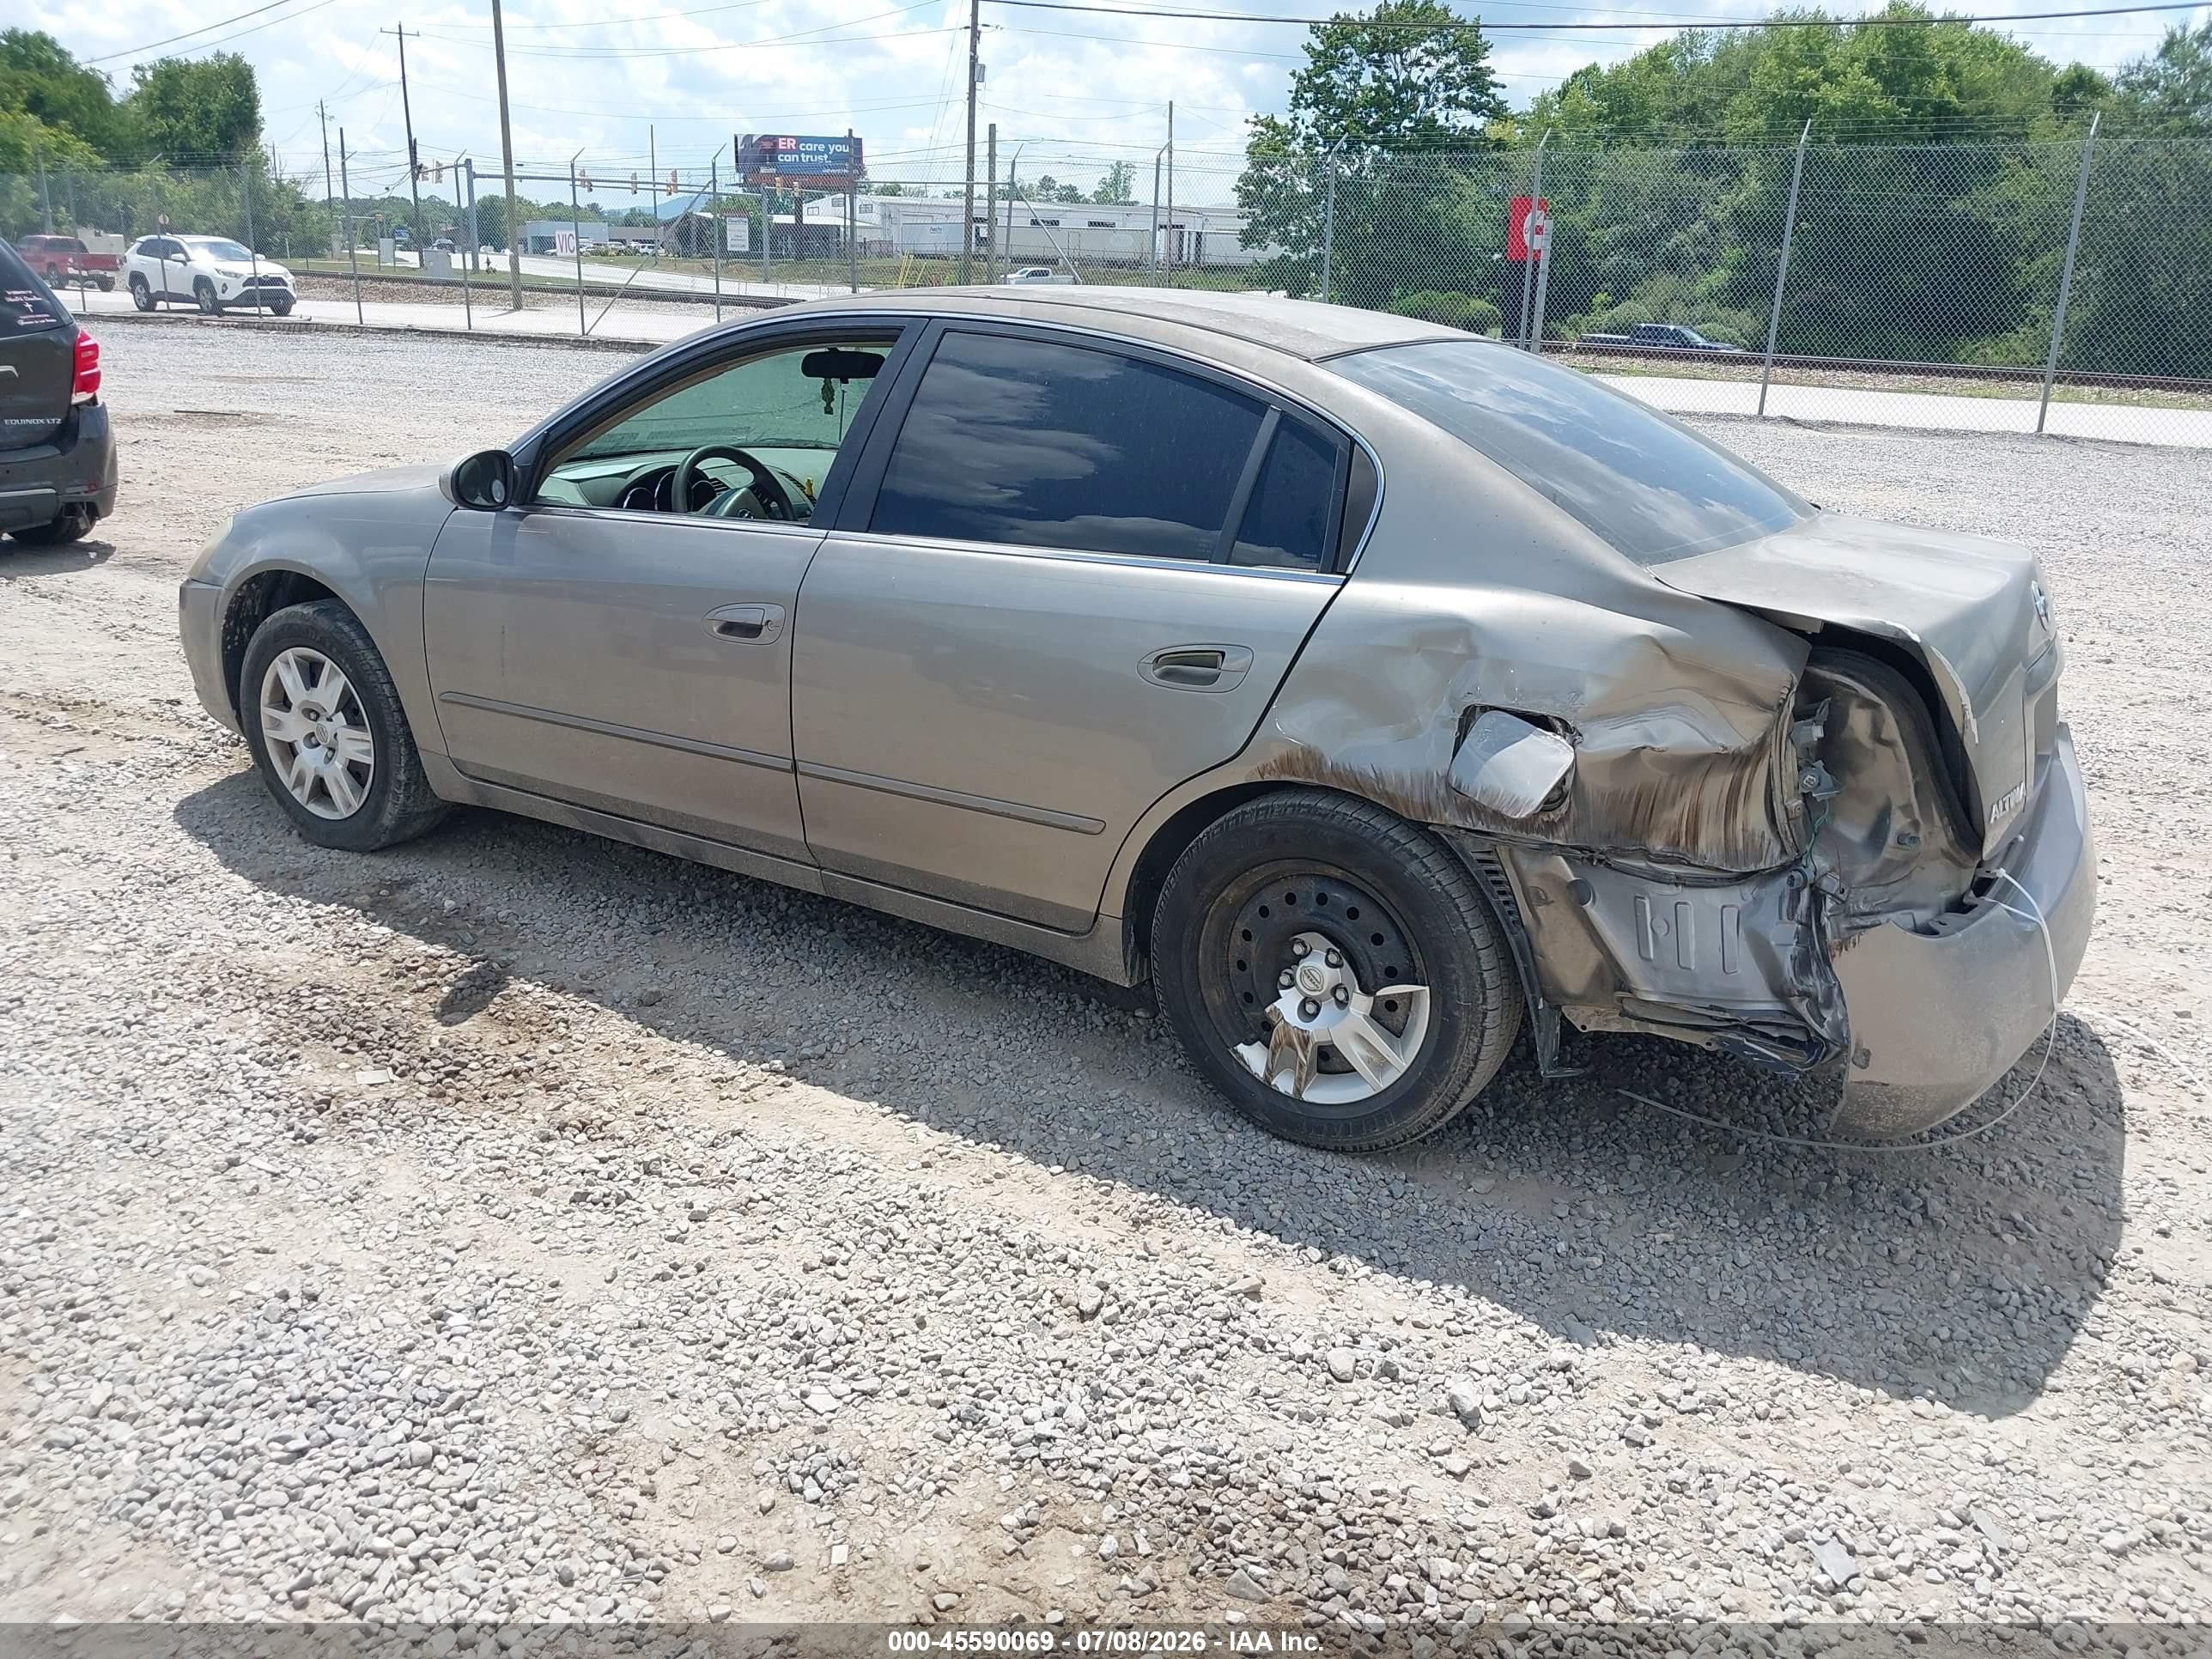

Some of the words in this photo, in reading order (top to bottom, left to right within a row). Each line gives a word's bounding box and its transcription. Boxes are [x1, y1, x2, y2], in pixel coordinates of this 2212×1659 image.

[778, 137, 797, 149] ER
[799, 142, 825, 151] care
[828, 143, 849, 155] you
[777, 154, 799, 162] can
[801, 153, 831, 163] trust.
[557, 233, 575, 253] VIC
